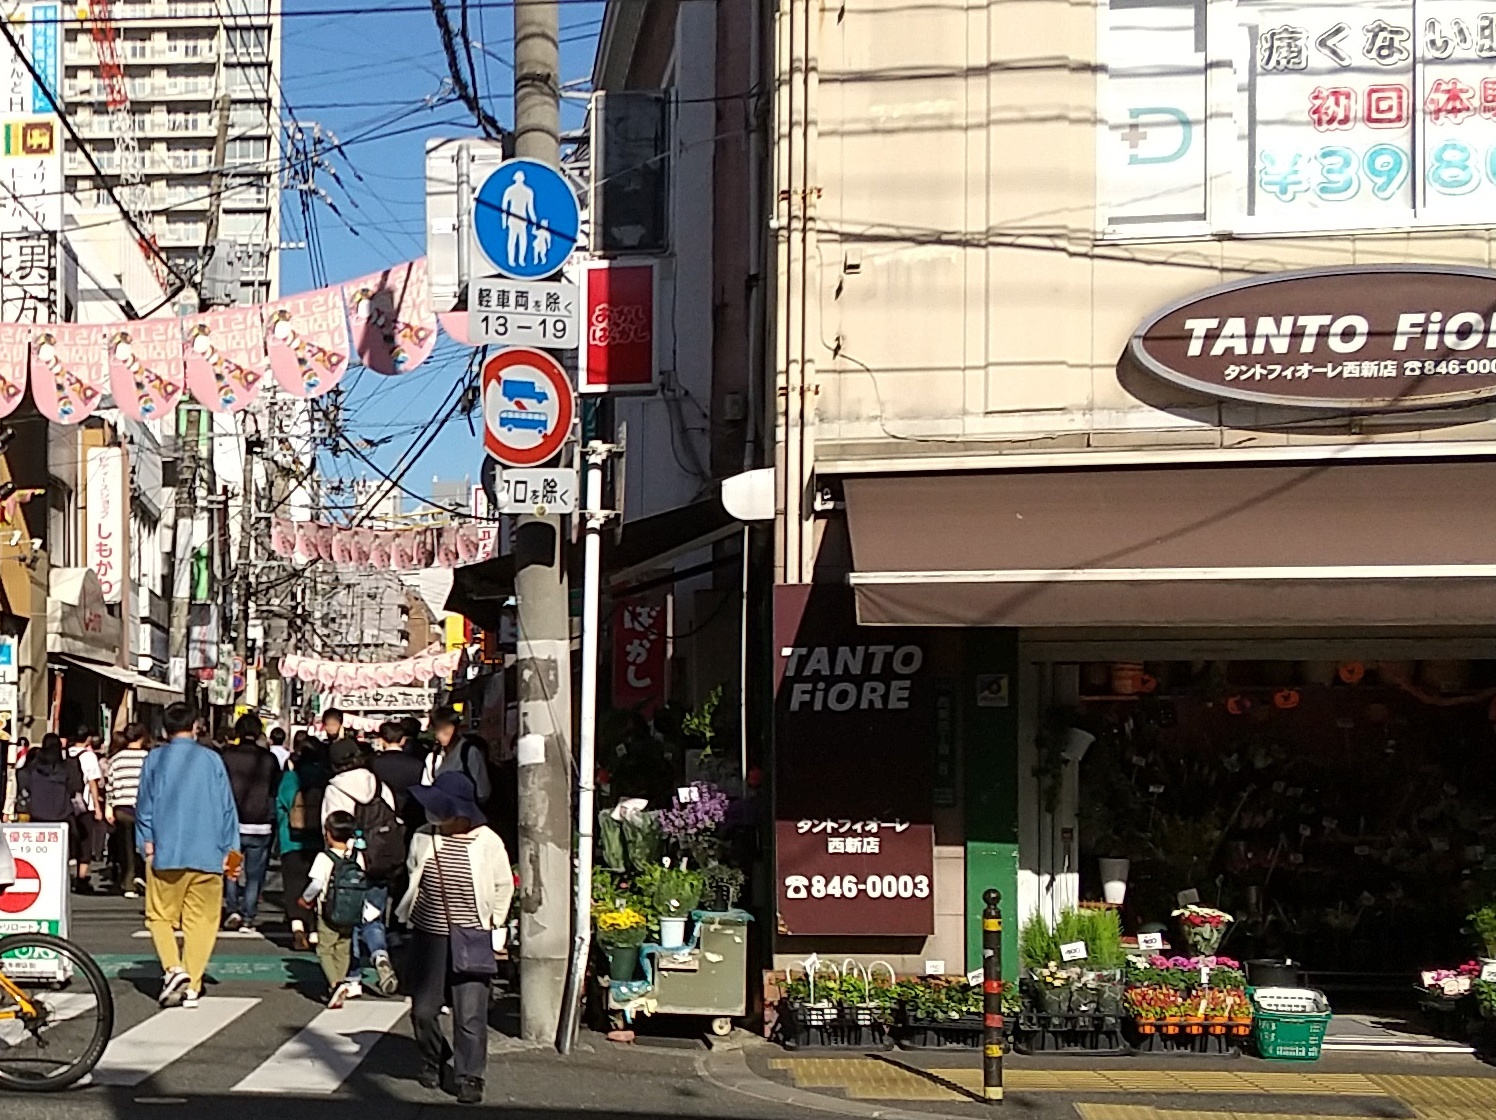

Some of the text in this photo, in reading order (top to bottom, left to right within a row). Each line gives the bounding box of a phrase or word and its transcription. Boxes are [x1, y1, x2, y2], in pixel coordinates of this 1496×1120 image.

[1260, 139, 1496, 203] ¥398
[477, 287, 573, 313] 軽車両を除く
[1184, 311, 1496, 357] TANTO FiO
[1224, 360, 1397, 381] タントフィオーレ西新店
[781, 645, 923, 677] TANTO
[789, 680, 912, 712] FiORE
[6, 831, 59, 843] 優先道路
[796, 818, 910, 833] タントフィオーレ
[827, 837, 881, 854] 西新店
[810, 874, 930, 899] 846-0003
